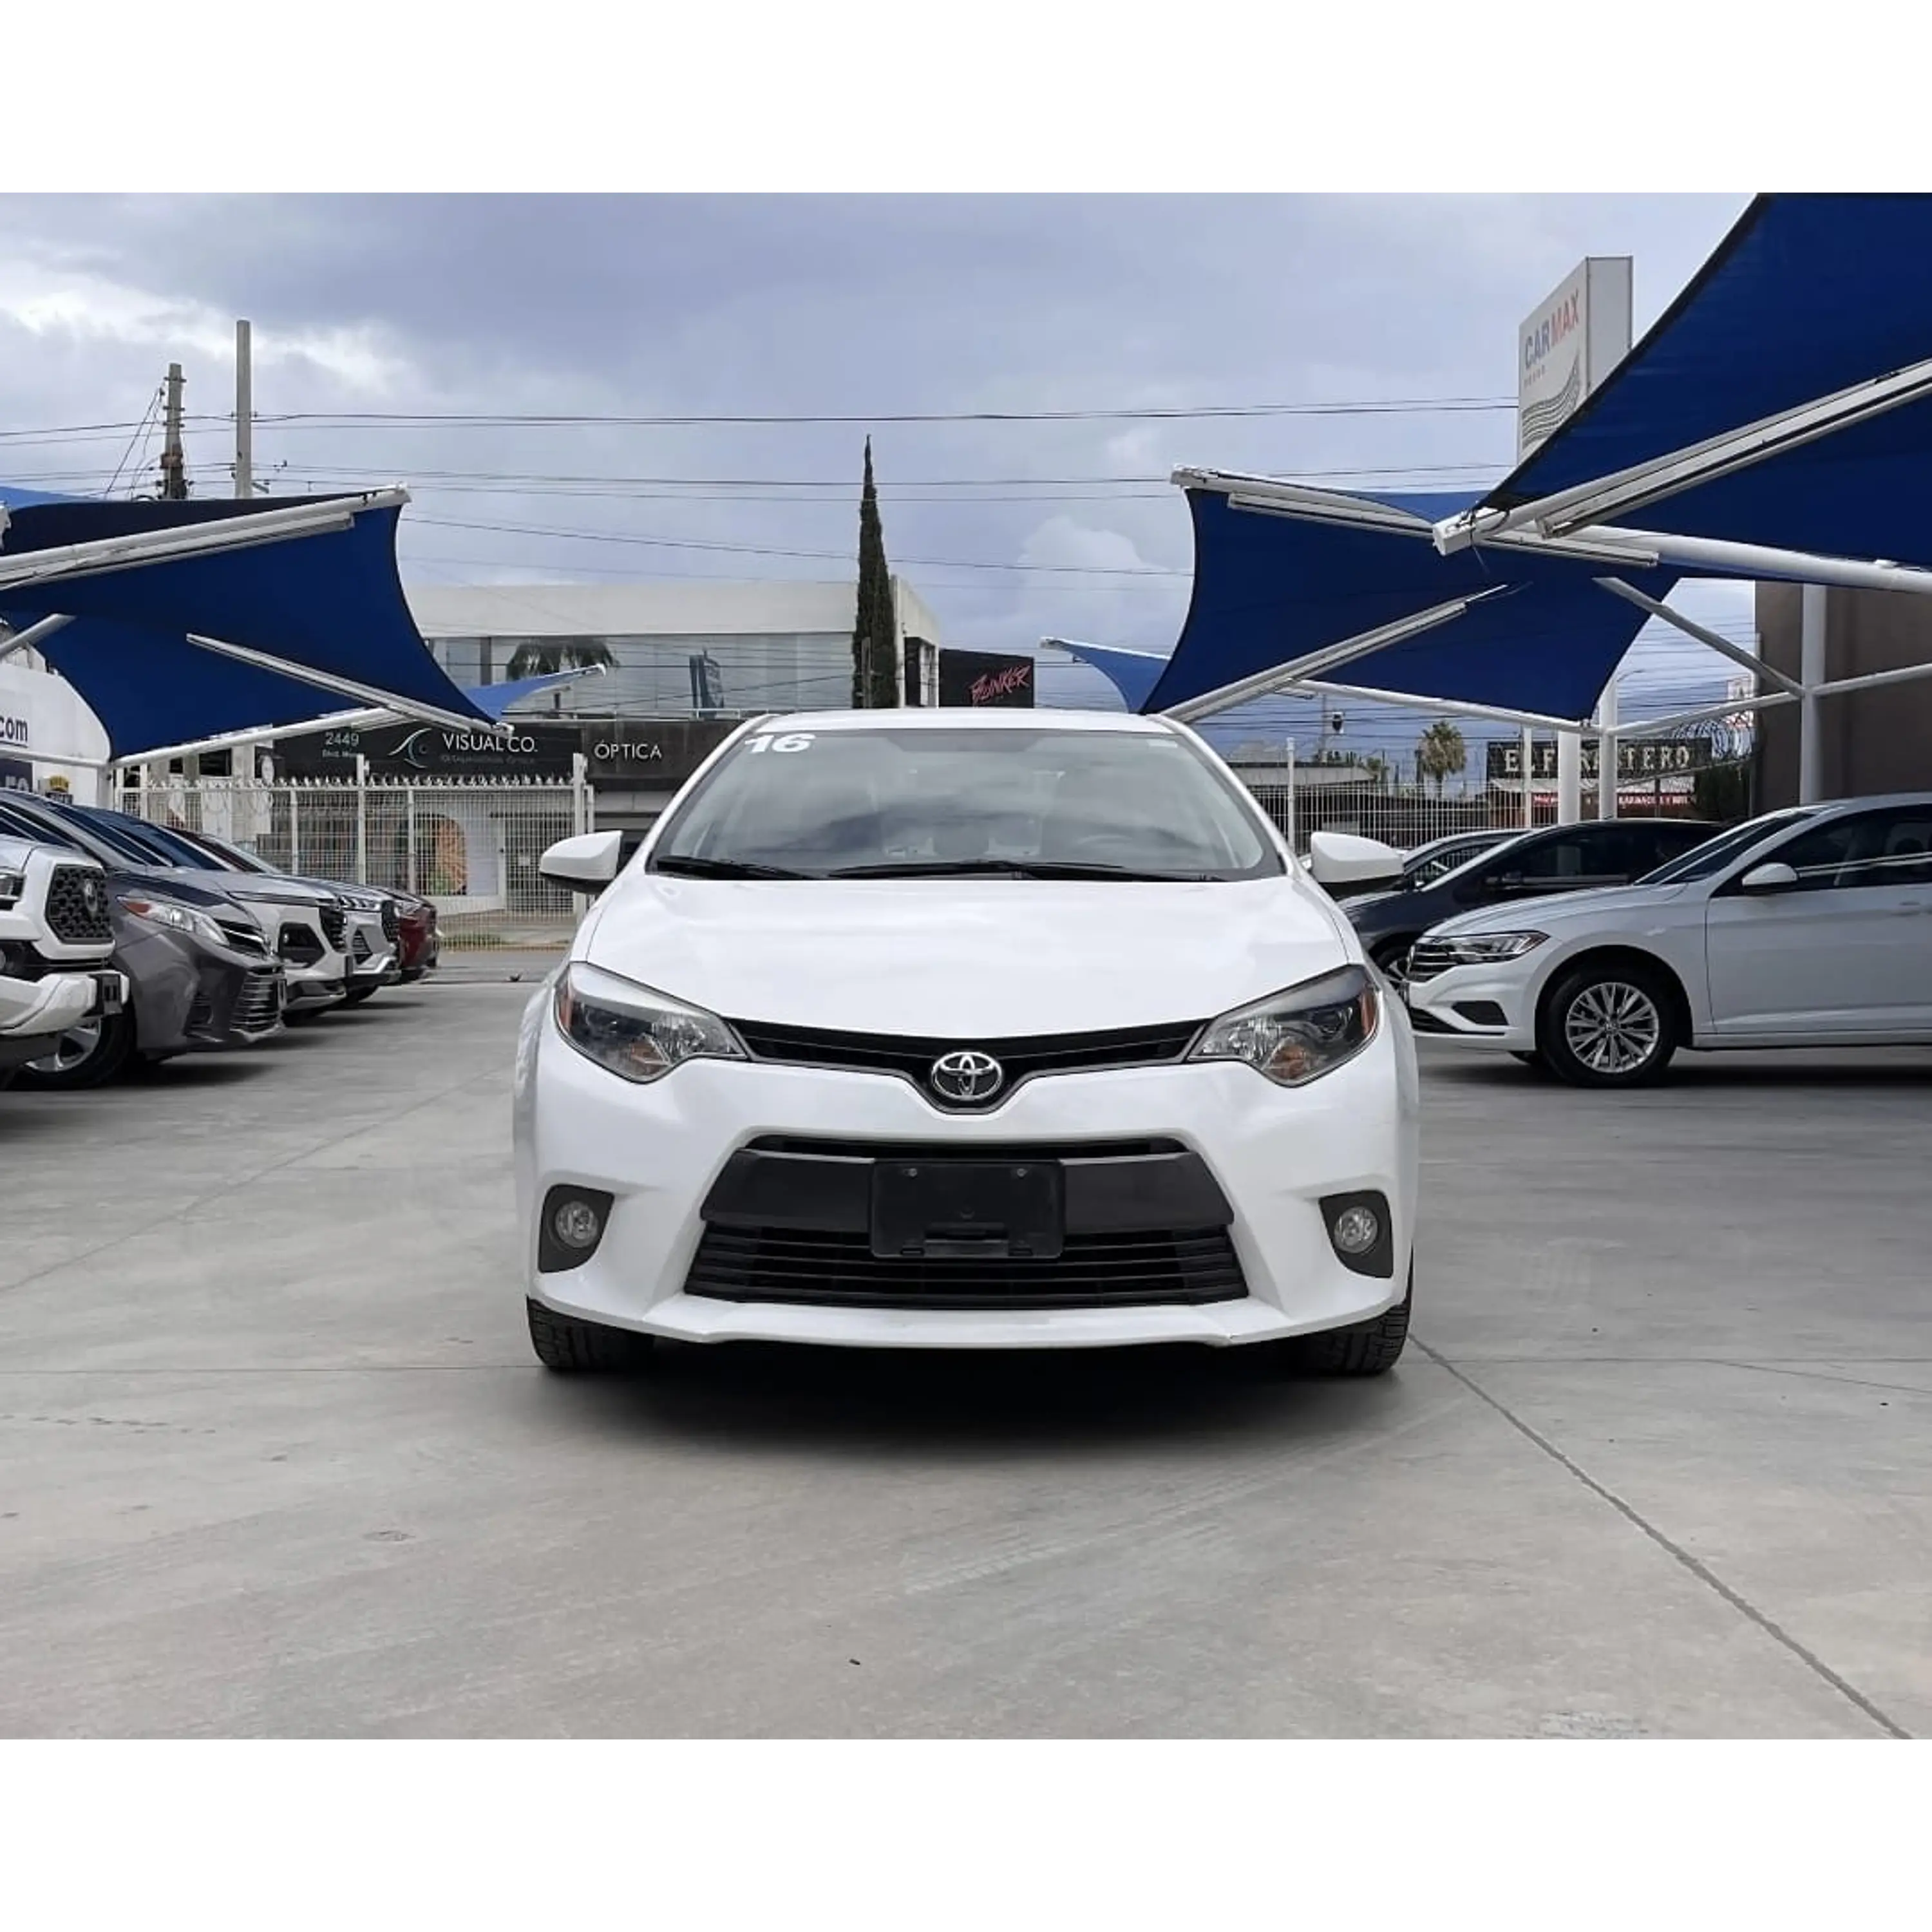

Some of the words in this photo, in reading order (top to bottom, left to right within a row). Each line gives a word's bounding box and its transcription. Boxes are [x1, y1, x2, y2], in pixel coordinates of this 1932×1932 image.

[1525, 288, 1578, 370] CARMAX
[442, 732, 504, 752] VISUAL
[594, 739, 662, 760] ÓPTICA
[744, 733, 817, 753] 16
